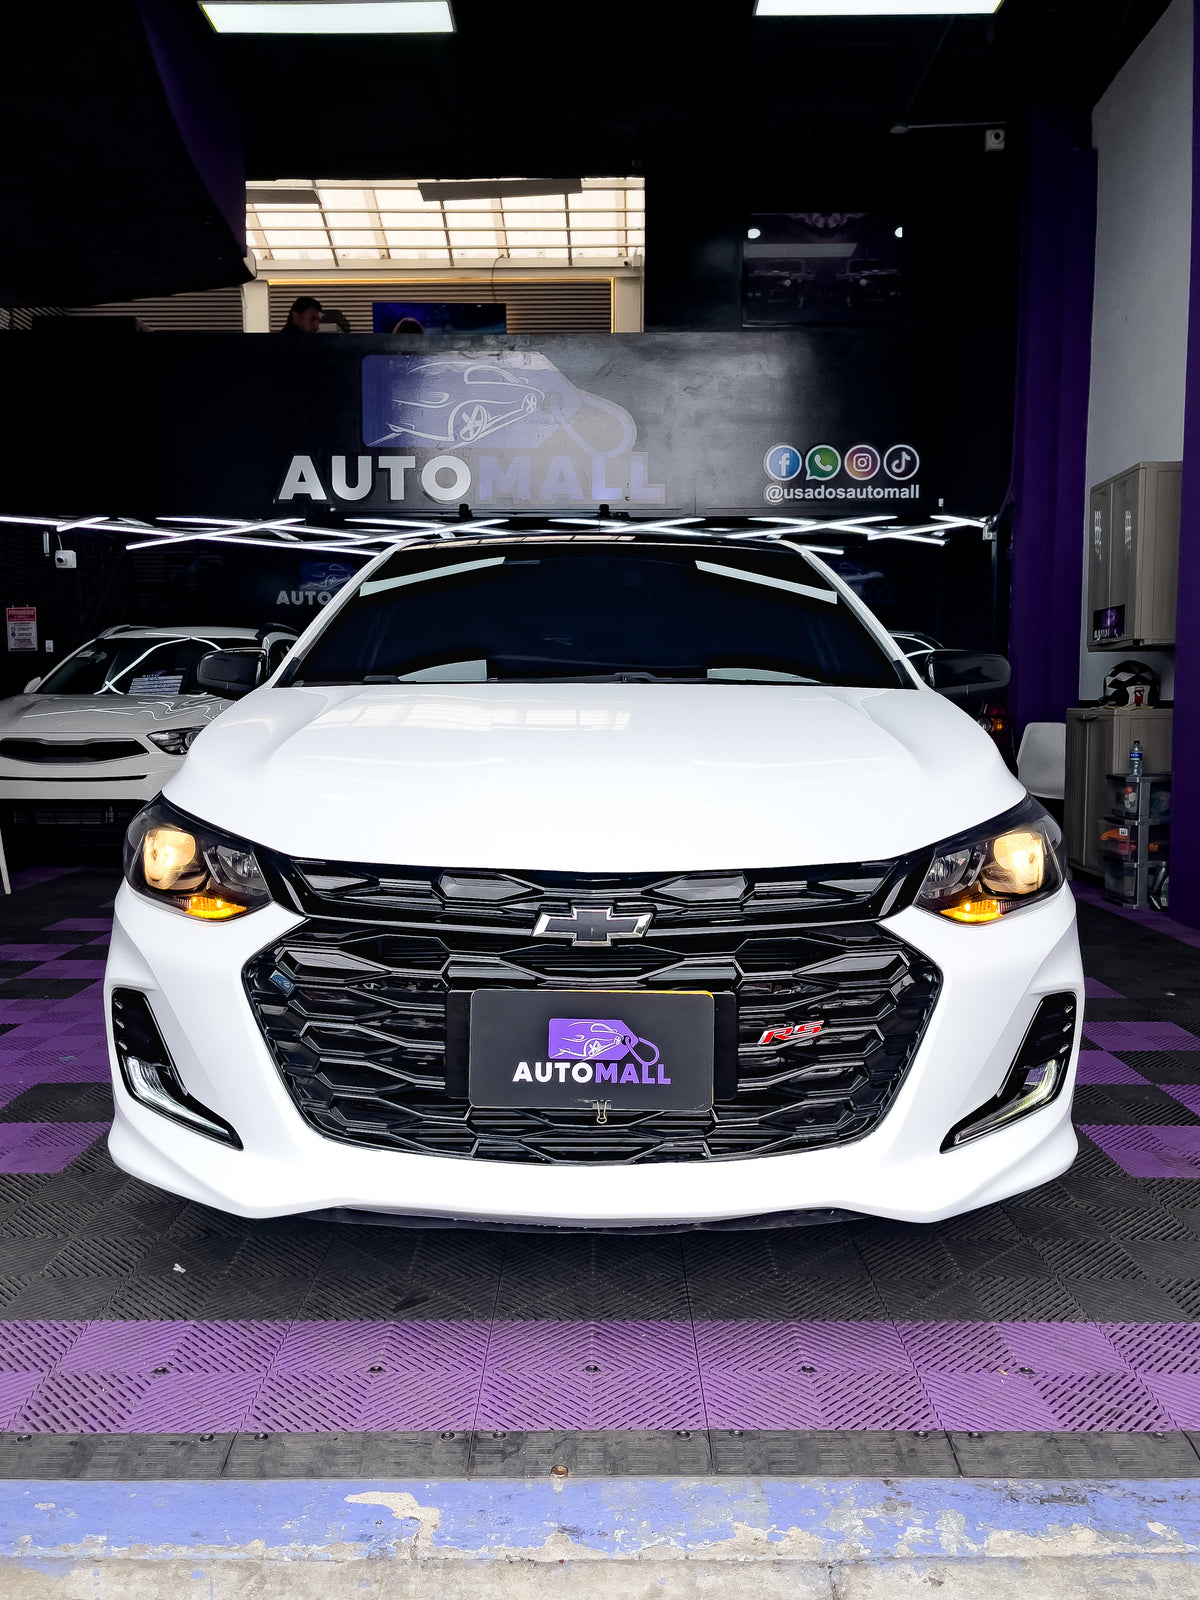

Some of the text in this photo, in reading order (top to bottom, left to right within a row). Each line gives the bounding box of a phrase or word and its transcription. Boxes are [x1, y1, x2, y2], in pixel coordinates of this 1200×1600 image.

[278, 455, 662, 501] AUTOMALL
[765, 484, 920, 503] @usadosautomall
[758, 1020, 824, 1045] RS
[512, 1061, 672, 1085] AUTOMALL
